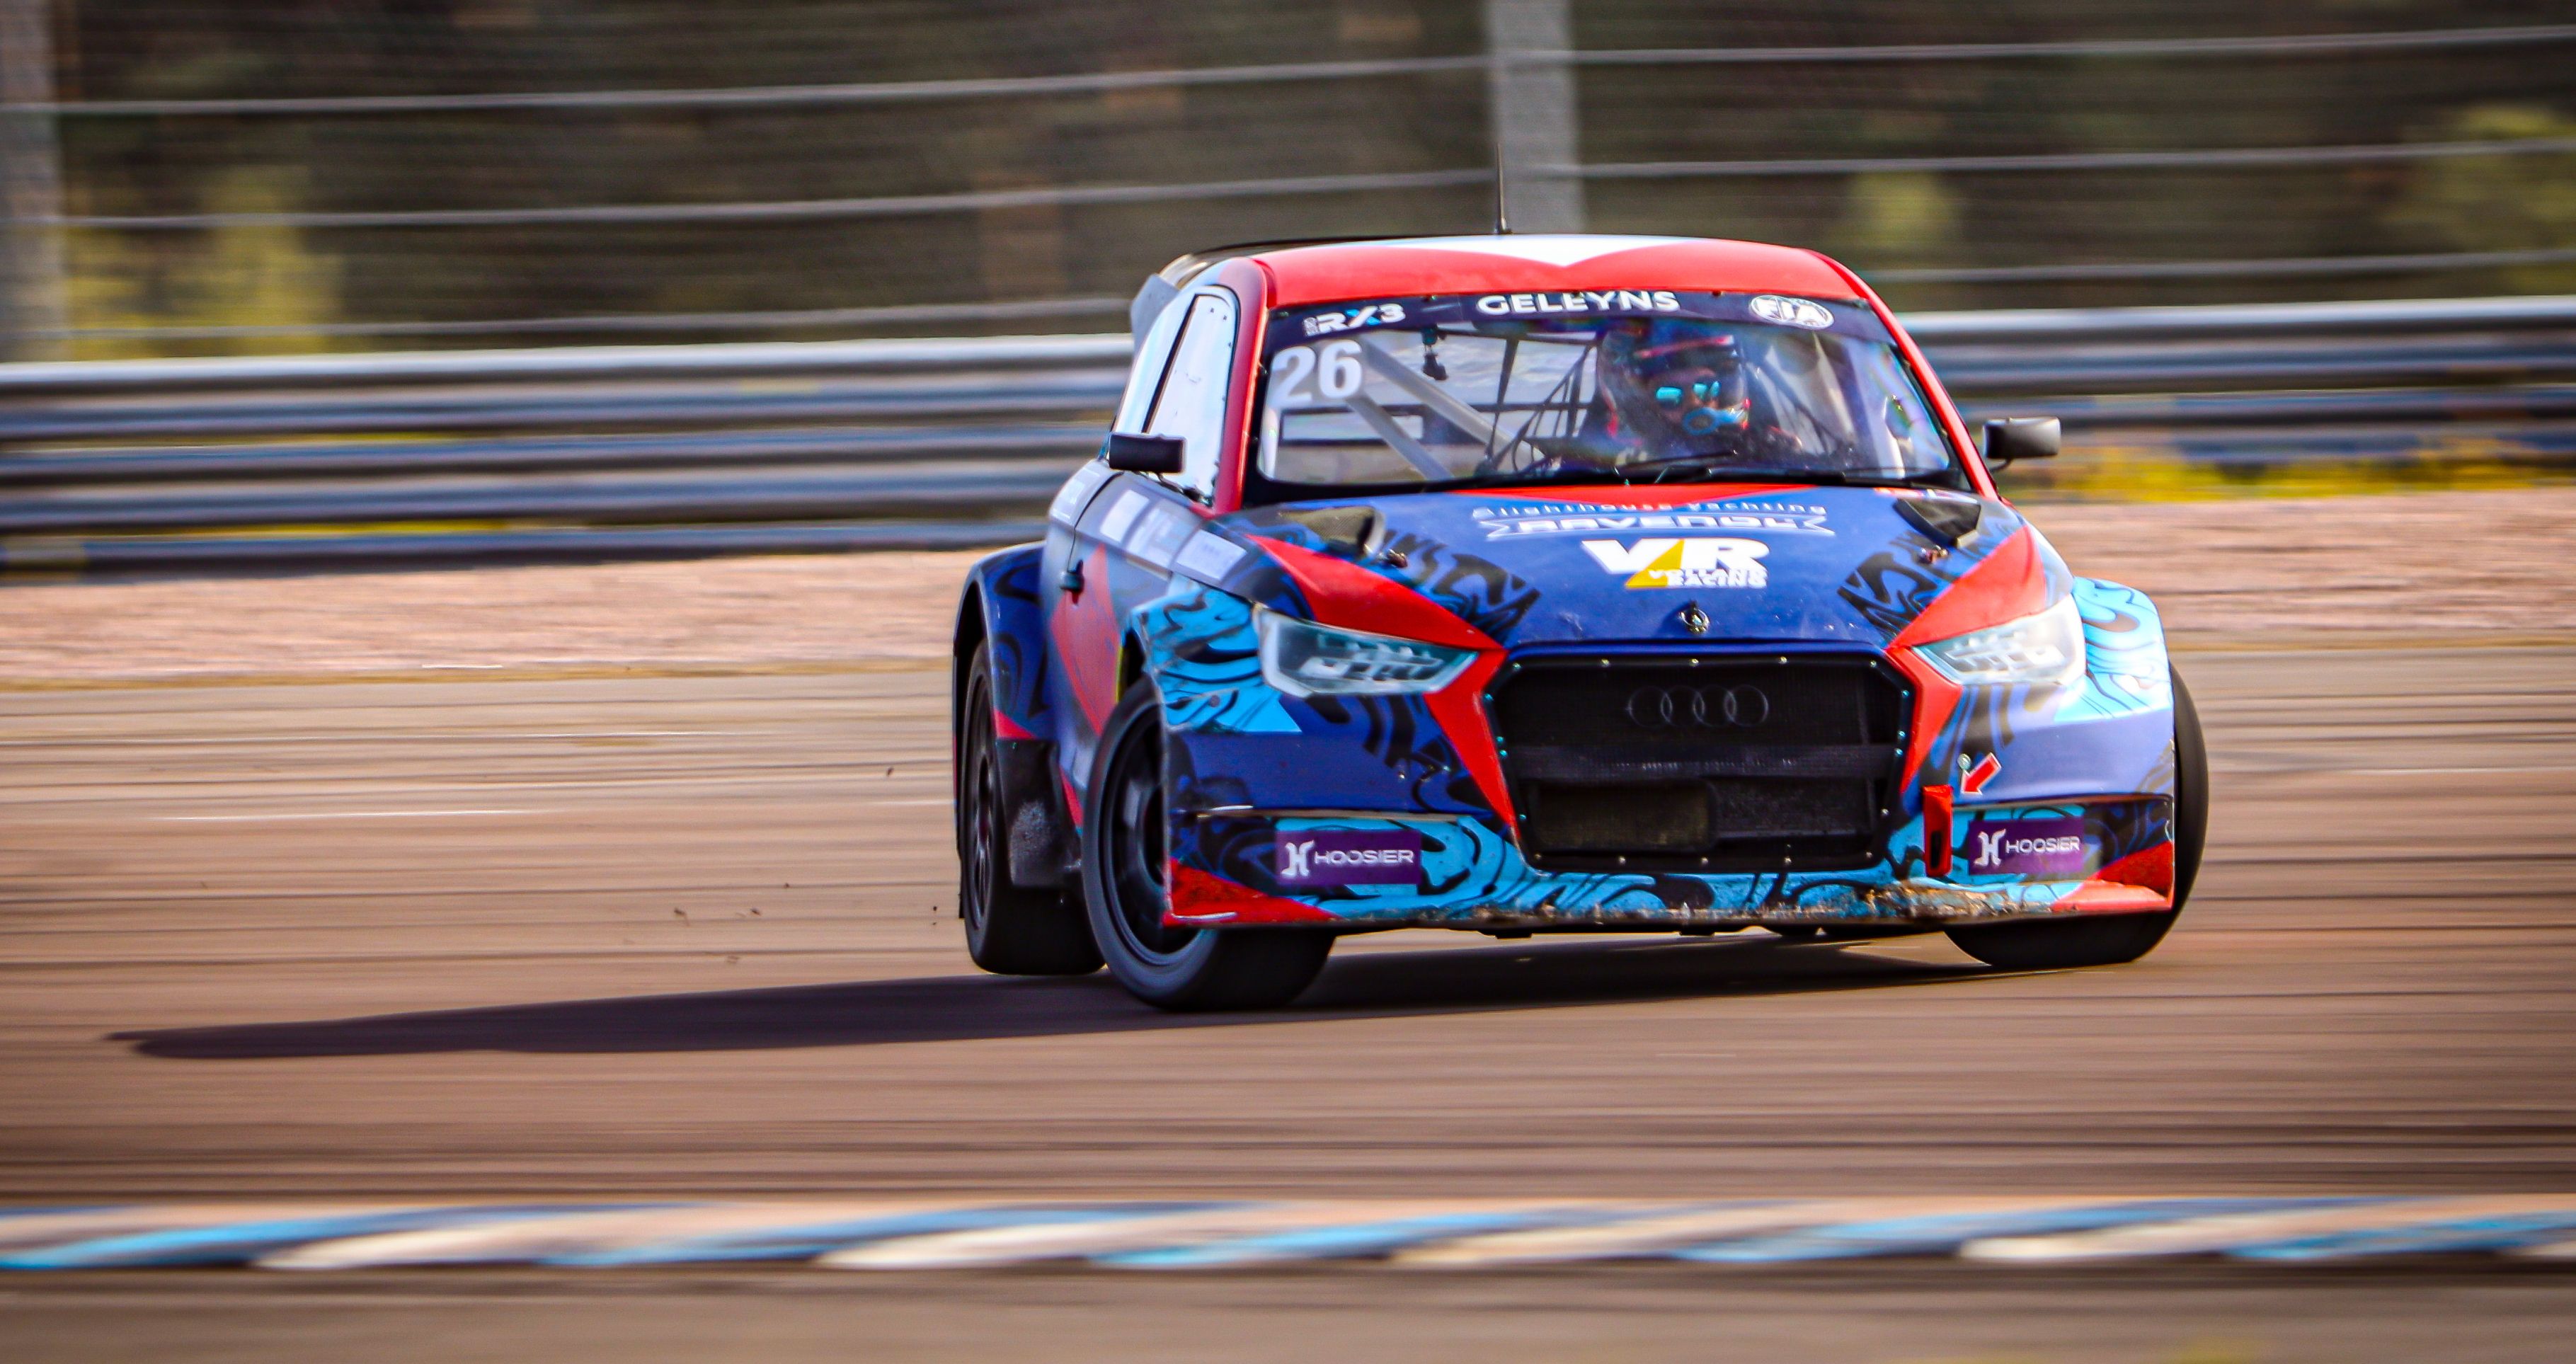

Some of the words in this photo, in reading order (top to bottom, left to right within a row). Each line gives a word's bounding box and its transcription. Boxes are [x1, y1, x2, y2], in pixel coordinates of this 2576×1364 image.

[1476, 290, 1681, 316] GELEYNS
[1756, 298, 1832, 326] FIA
[1268, 339, 1363, 404] 26
[1580, 537, 1770, 575] VR
[1314, 849, 1414, 866] HOOSIER
[2005, 836, 2080, 854] HOOSIER
